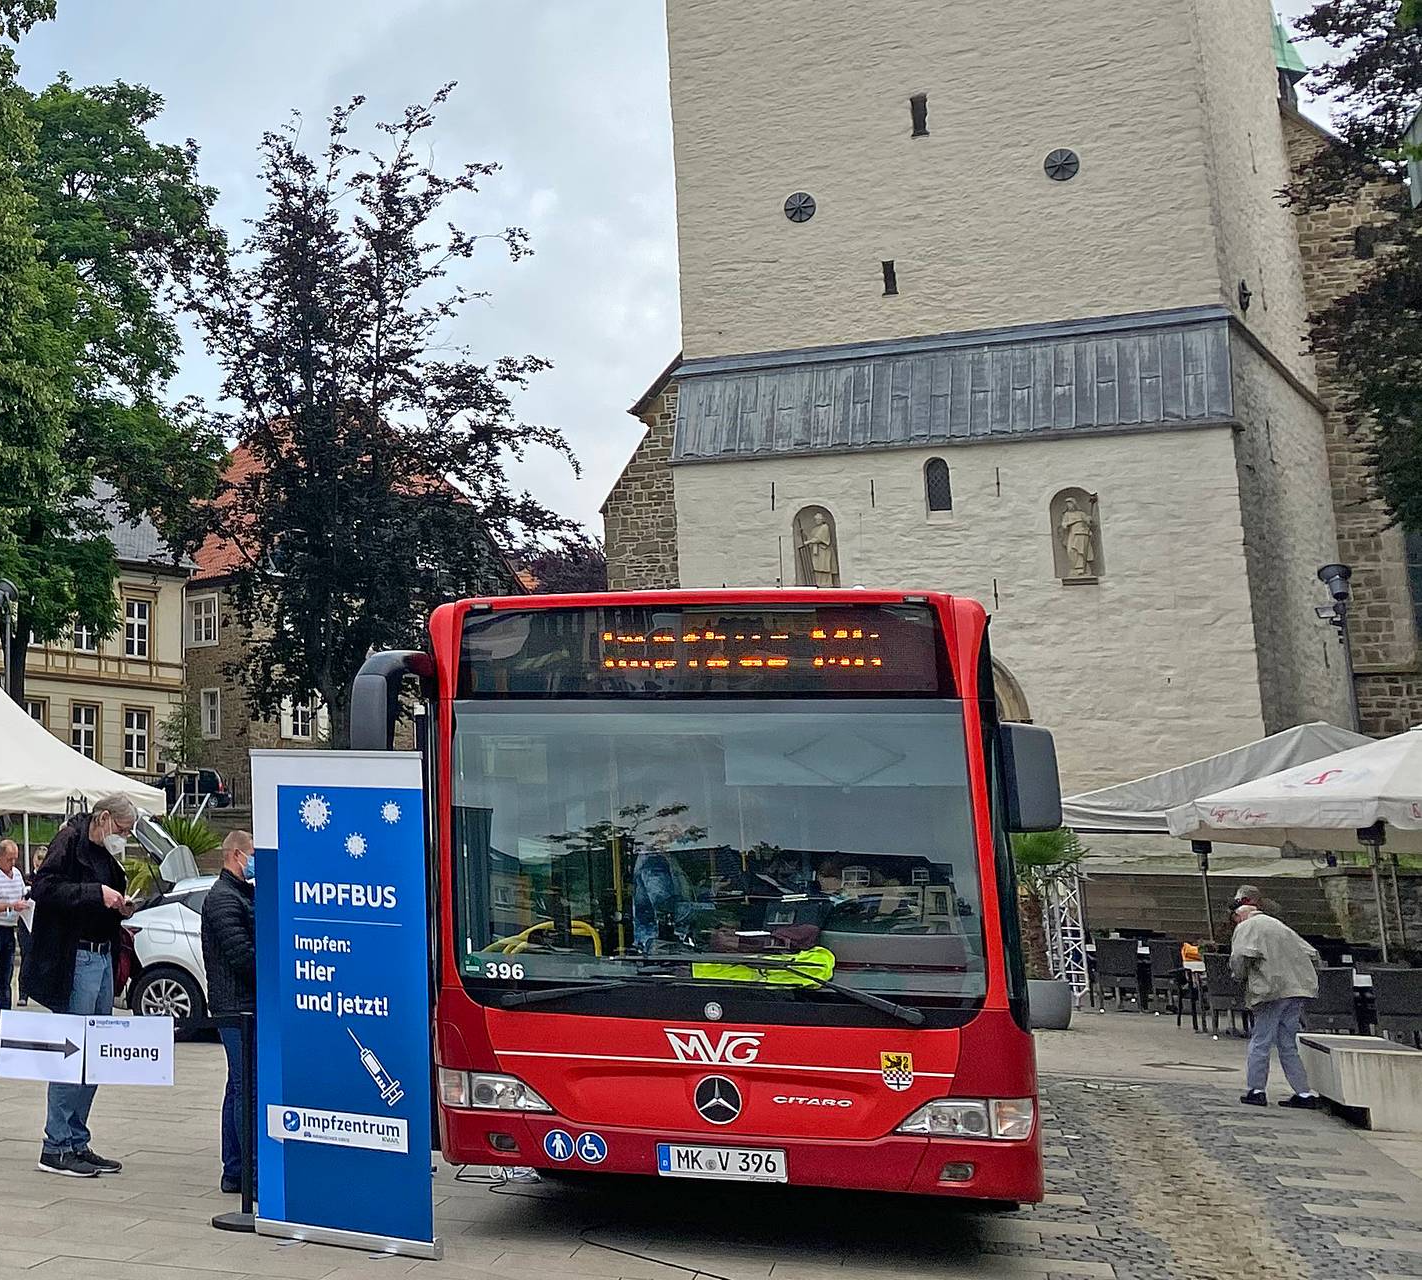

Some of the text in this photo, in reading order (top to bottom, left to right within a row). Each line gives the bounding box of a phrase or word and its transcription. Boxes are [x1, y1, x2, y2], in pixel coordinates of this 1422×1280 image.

[294, 881, 397, 909] IMPFBUS
[294, 934, 351, 954] Impfen:
[295, 959, 336, 982] Hier
[485, 962, 525, 980] 396
[296, 991, 389, 1017] und jetzt!
[100, 1043, 159, 1061] Eingang
[663, 1028, 765, 1064] MVG
[772, 1095, 853, 1108] CITARO
[303, 1112, 401, 1138] Impfzentrum
[676, 1149, 777, 1173] MK V 396
